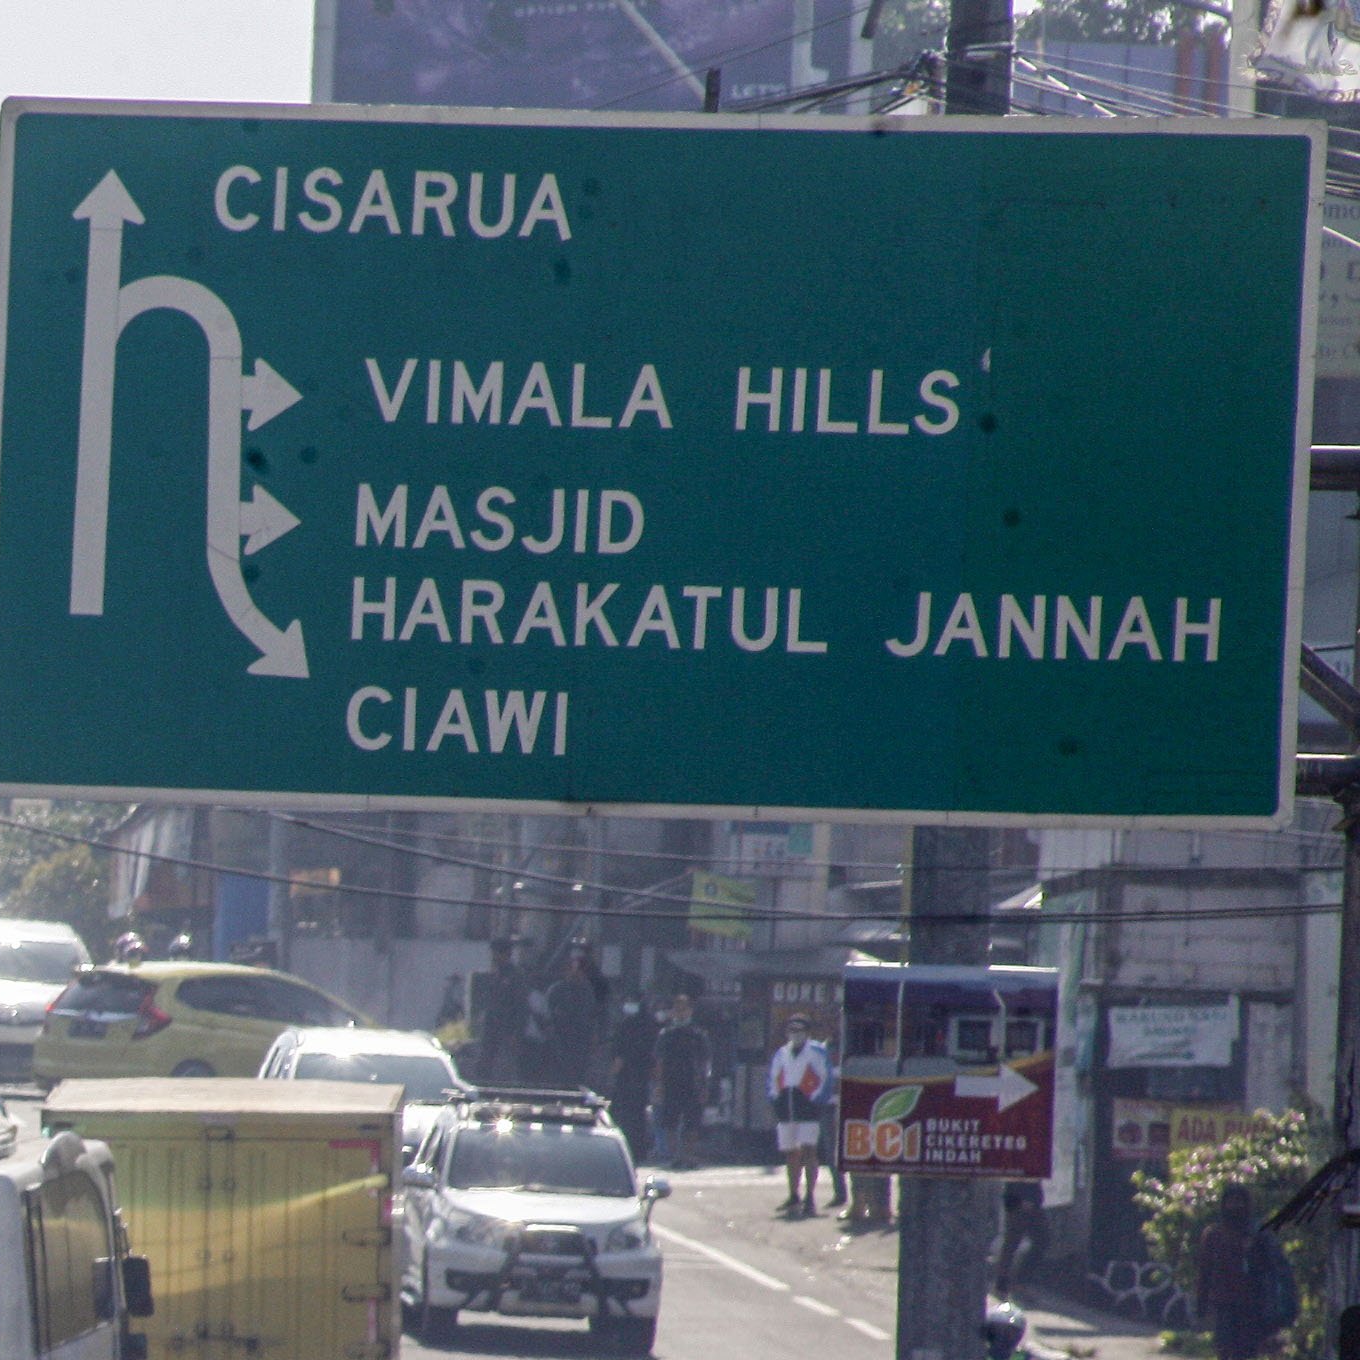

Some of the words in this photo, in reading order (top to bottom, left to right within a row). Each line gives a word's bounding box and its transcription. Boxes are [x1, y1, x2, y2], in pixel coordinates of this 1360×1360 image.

[215, 165, 571, 241] CISARUA
[365, 359, 672, 428] VIMALA
[735, 367, 959, 435] HILLS
[355, 483, 644, 554] MASJID
[351, 577, 827, 653] HARAKATUL
[885, 592, 1221, 661] JANNAH
[347, 686, 567, 755] CIAWI
[925, 1117, 980, 1133] BUKIT
[925, 1149, 980, 1163] INDAH
